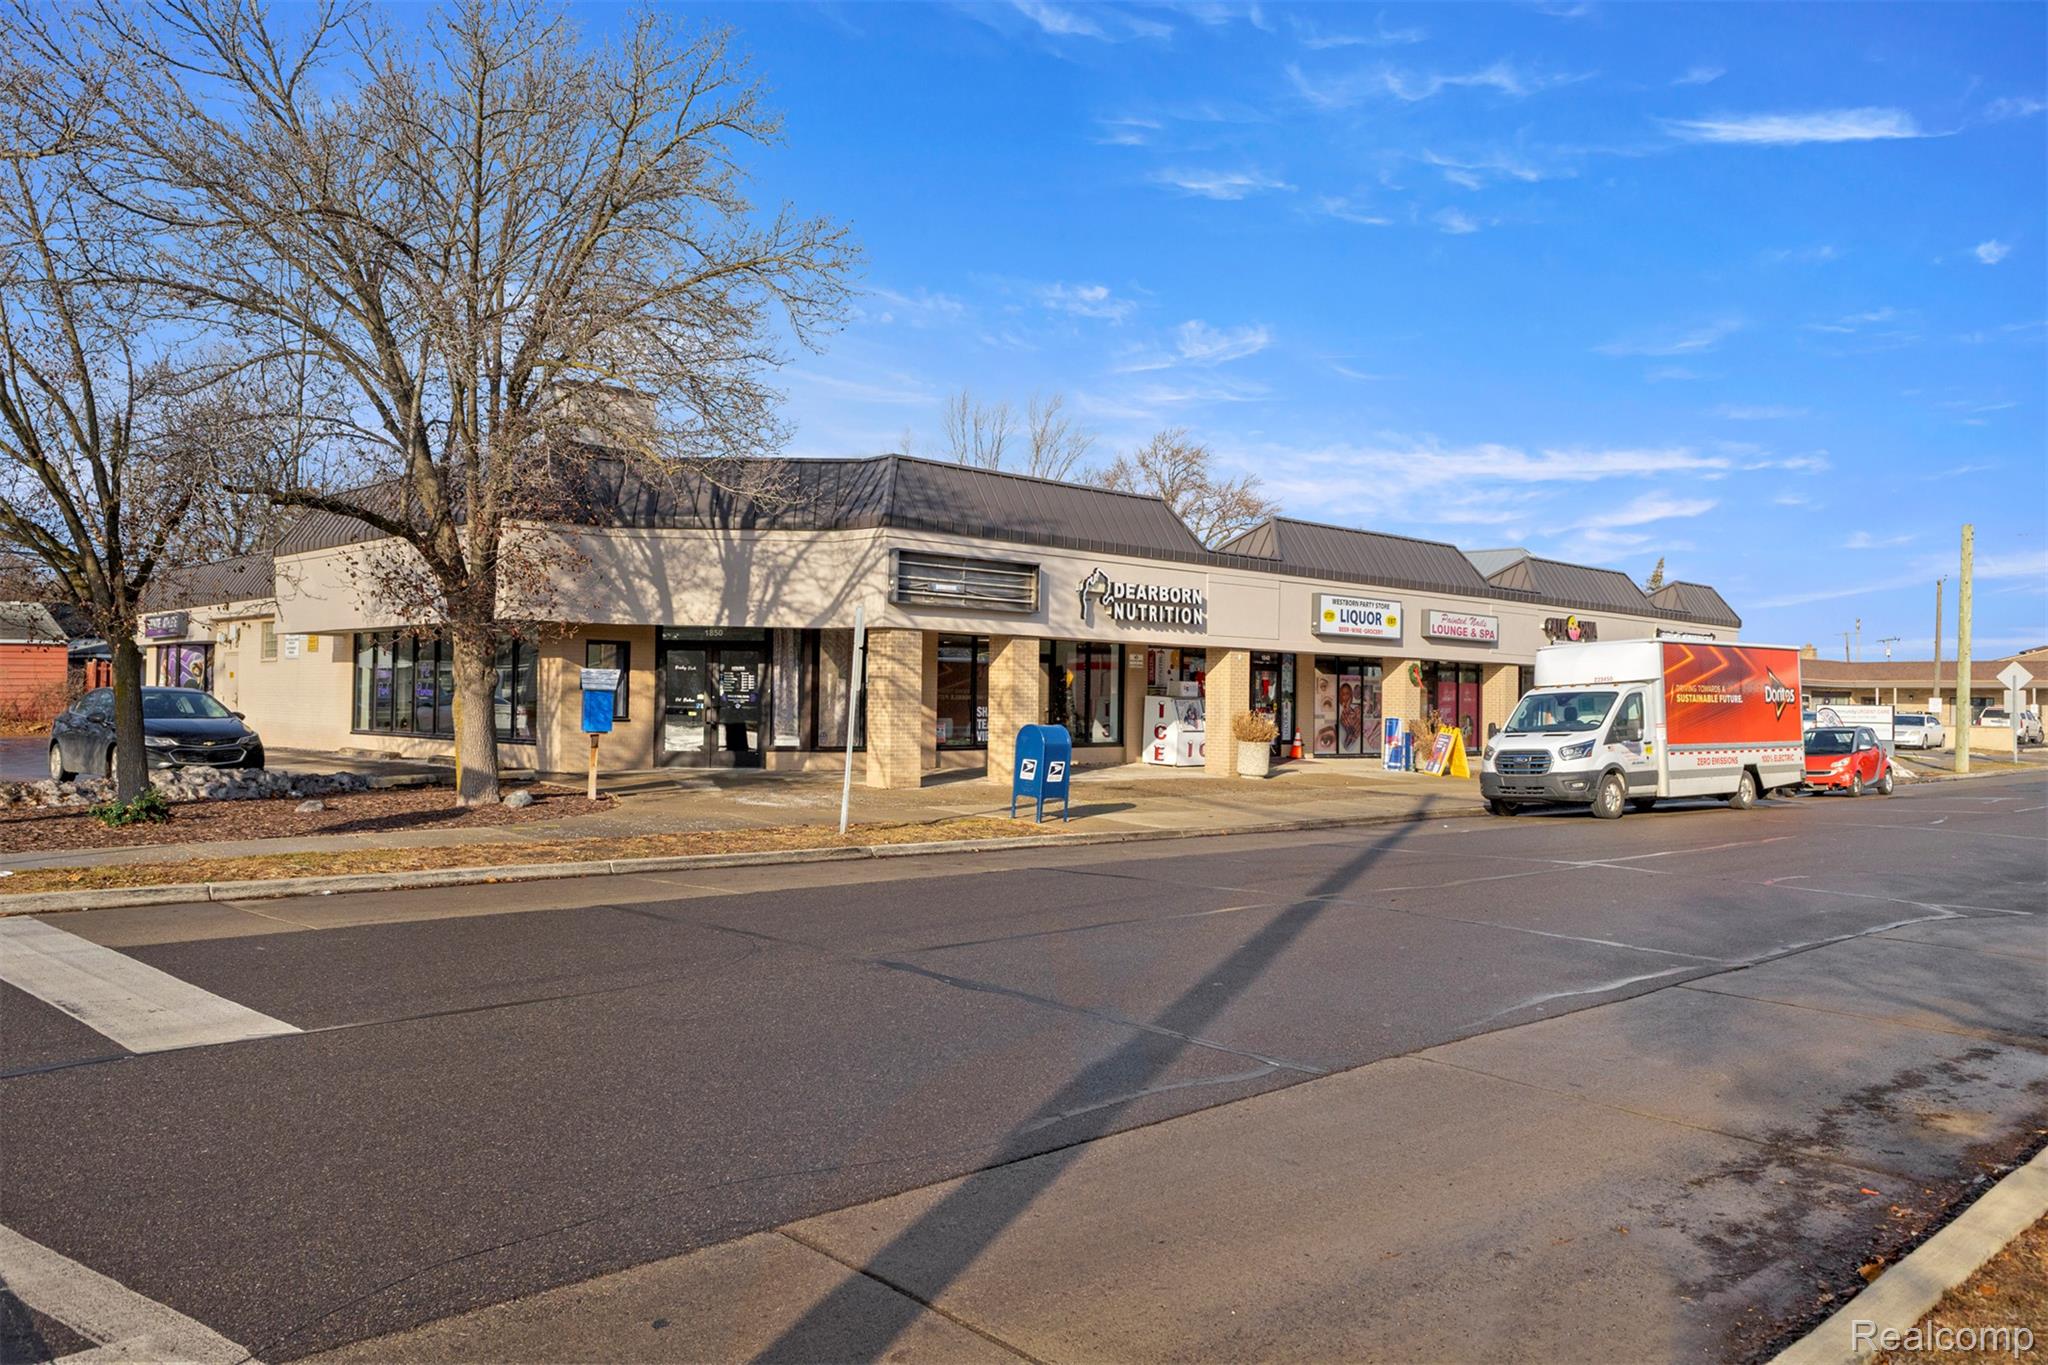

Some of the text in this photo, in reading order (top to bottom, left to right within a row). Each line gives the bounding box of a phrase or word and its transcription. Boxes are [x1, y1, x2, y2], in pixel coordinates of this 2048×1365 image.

[1112, 582, 1203, 604] DEARBORN
[1332, 598, 1390, 610] WESTBORN PARTY STORE
[1112, 602, 1203, 625] NUTRITION
[1340, 608, 1382, 626] LIQUOR
[705, 629, 723, 637] 1850
[1432, 624, 1495, 639] LOUNGE & SPA
[1698, 685, 1721, 693] TOWARDS
[1722, 685, 1726, 693] A
[1764, 685, 1796, 704] Doritos
[1676, 694, 1743, 703] SUSTAINABLE FUTURE.
[1154, 701, 1167, 761] ICE
[1697, 756, 1738, 766] ZERO EMISSIONS
[1774, 753, 1794, 762] ELECTRIC
